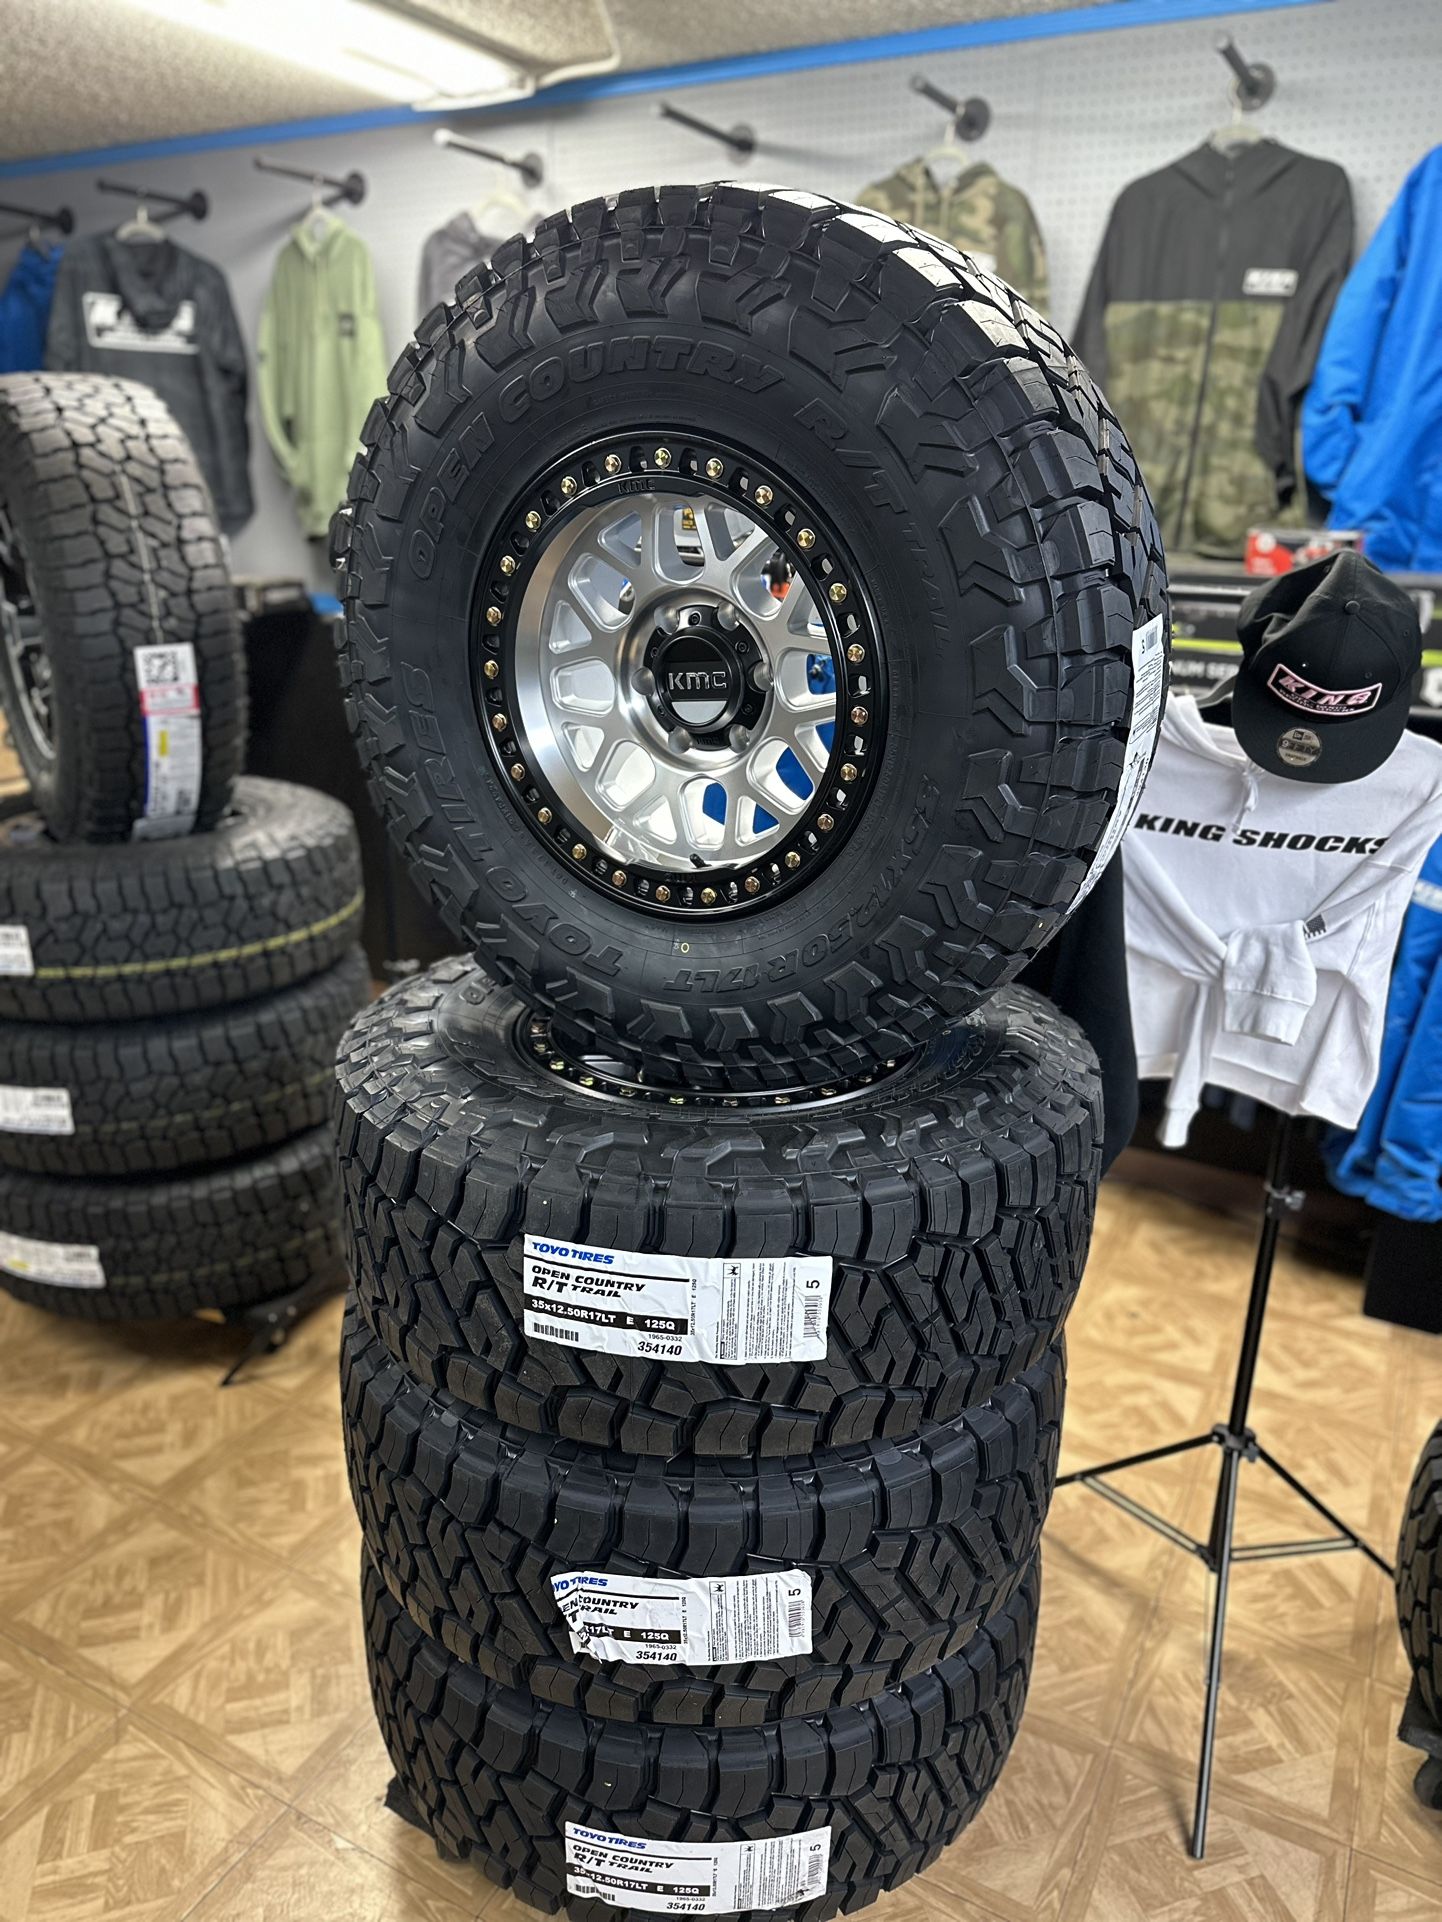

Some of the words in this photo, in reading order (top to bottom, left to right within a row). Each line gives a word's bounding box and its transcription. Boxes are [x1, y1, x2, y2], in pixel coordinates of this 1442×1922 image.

[408, 411, 495, 579] OPEN
[498, 335, 784, 424] COUNTRY
[793, 397, 908, 515] R/T
[668, 671, 727, 690] KMC
[1279, 675, 1371, 705] KING
[399, 661, 494, 861] TIRES
[1134, 813, 1225, 842] KING
[1232, 829, 1389, 854] SHOCKS
[486, 866, 623, 976] TOYO
[532, 1241, 569, 1257] TOYO
[570, 1248, 615, 1264] TIRES
[532, 1265, 570, 1281] OPEN
[575, 1274, 646, 1292] COUNTRY
[532, 1276, 568, 1293] R/T
[571, 1285, 622, 1298] TRAIL
[806, 1280, 820, 1290] 5
[531, 1299, 616, 1323] 35x12.50R17LT
[626, 1316, 635, 1325] E
[644, 1319, 675, 1331] 125Q
[648, 1333, 683, 1342] 1965-0332
[637, 1341, 683, 1356] 354140
[788, 1588, 801, 1596] 5
[623, 1630, 632, 1638] E
[640, 1631, 670, 1640] 125Q
[636, 1651, 678, 1662] 354140
[573, 1828, 606, 1842] TOYO
[608, 1836, 647, 1849] TIRES
[810, 1843, 822, 1852] 5
[573, 1844, 608, 1858] OPEN
[612, 1855, 674, 1869] COUNTRY
[574, 1852, 605, 1867] R/T
[609, 1861, 653, 1873] TRAIL
[673, 1886, 700, 1894] 125Q
[666, 1902, 706, 1912] 354140
